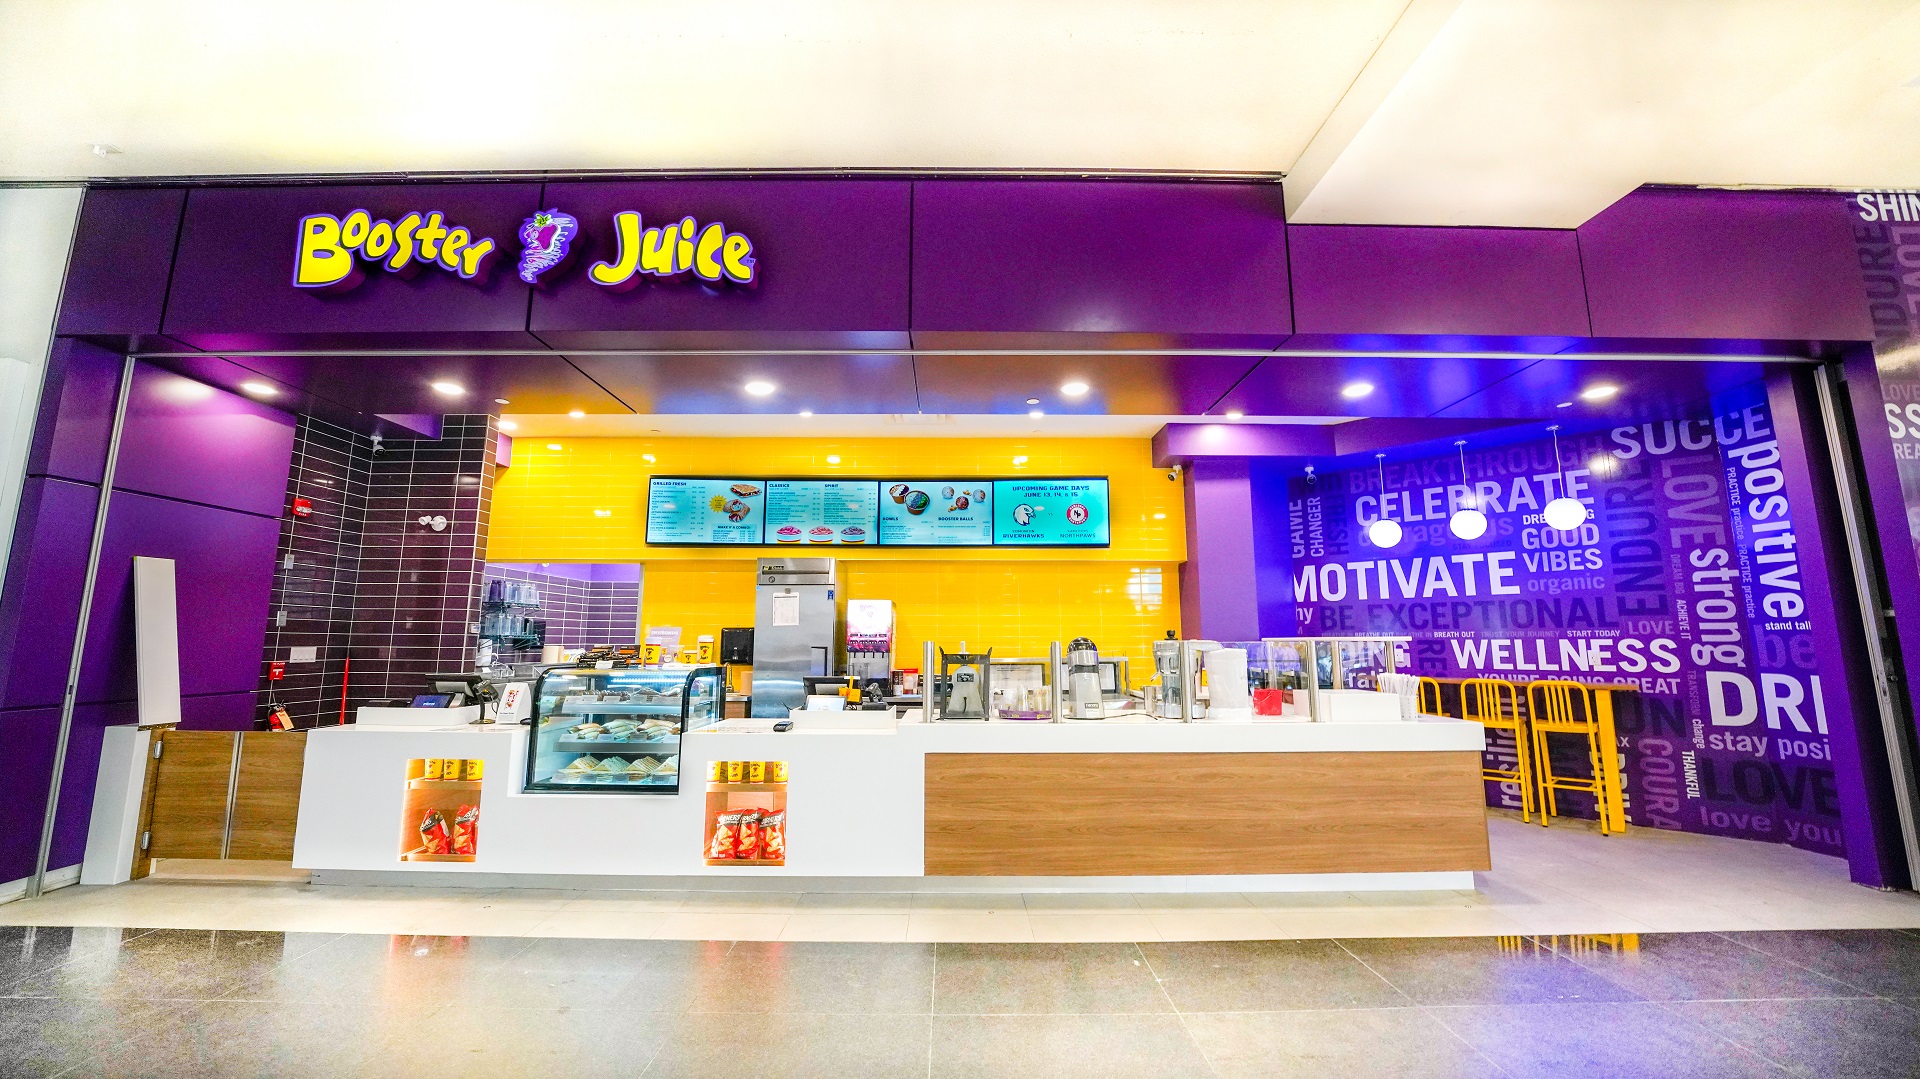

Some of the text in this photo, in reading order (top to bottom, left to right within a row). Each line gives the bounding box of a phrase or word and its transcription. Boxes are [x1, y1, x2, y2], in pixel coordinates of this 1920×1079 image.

[294, 208, 495, 287] Booster
[588, 210, 755, 286] Juice
[1350, 435, 1606, 495] BREAKTHROUGH
[1726, 466, 1741, 506] PRACTICE
[1355, 469, 1595, 527] CELEBRATE
[1660, 454, 1726, 549] LOVE
[1307, 496, 1324, 557] CHANGER
[1522, 524, 1600, 550] GOOD
[1728, 440, 1805, 618] positive
[1293, 551, 1521, 603] MOTIVATE
[1523, 548, 1604, 573] VIBES
[1527, 571, 1606, 595] organic
[1320, 597, 1620, 632] BE EXCEPTIONAL
[1628, 620, 1676, 635] LOVE
[1676, 599, 1690, 631] ACHIEVE
[1689, 548, 1747, 668] strong
[1765, 620, 1792, 631] stand
[1450, 638, 1681, 673] WELLNESS
[1754, 624, 1818, 669] be
[1705, 670, 1829, 735] DRI
[1692, 718, 1706, 749] change
[1709, 731, 1832, 761] stay posi
[1682, 749, 1700, 800] THANKFUL
[1701, 805, 1842, 847] love you
